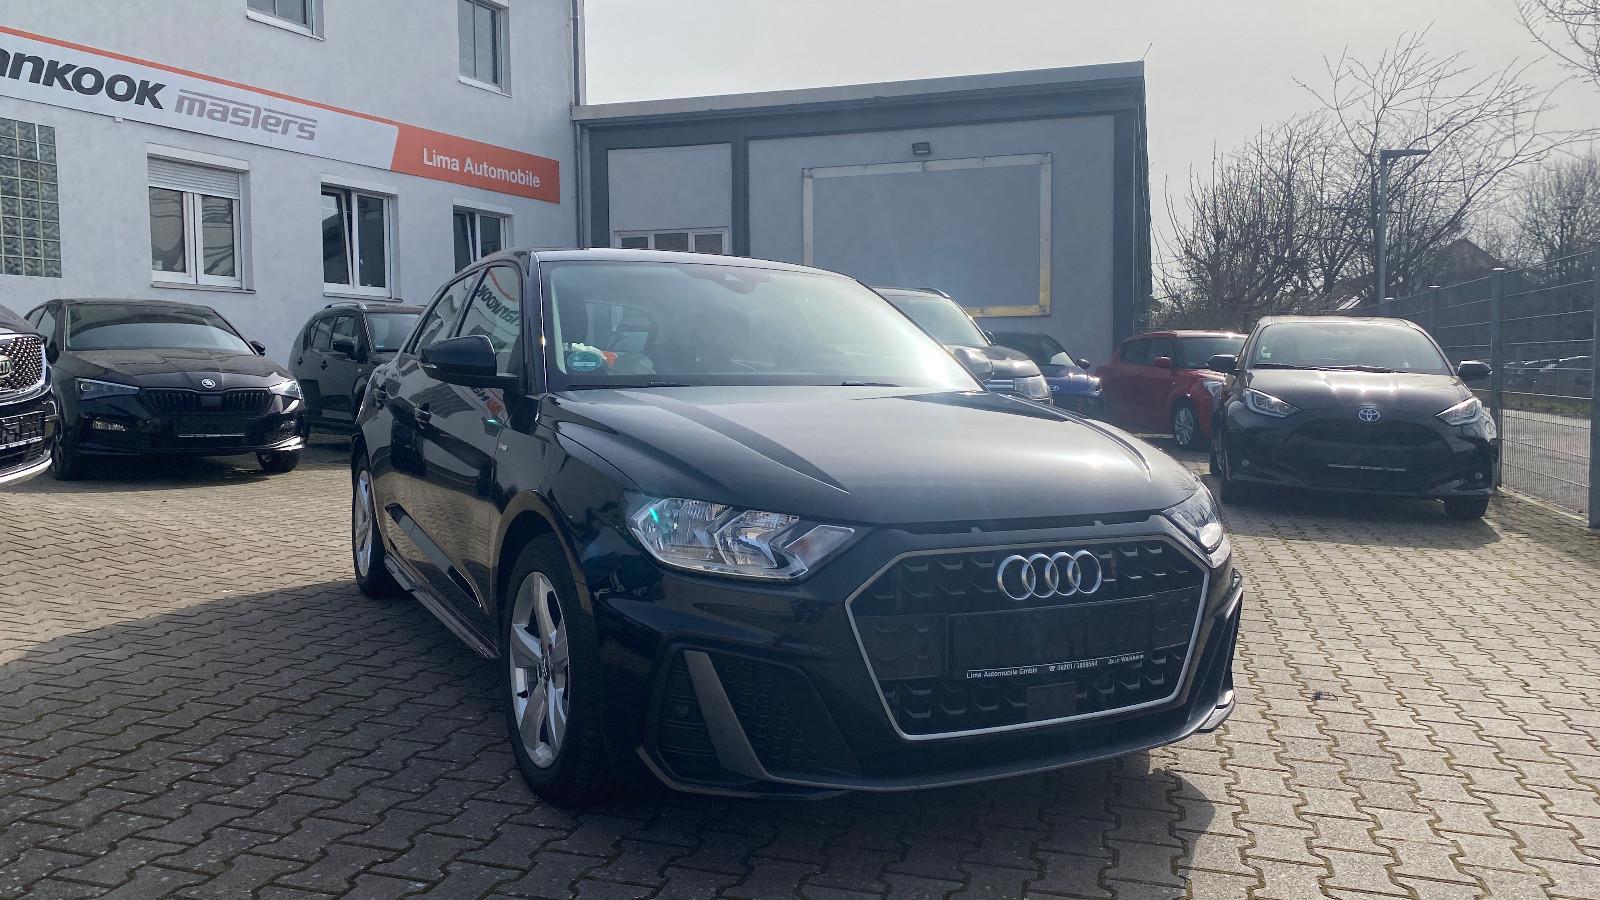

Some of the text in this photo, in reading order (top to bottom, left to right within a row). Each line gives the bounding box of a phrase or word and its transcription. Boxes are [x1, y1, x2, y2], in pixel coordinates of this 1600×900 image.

[174, 89, 318, 141] masters
[423, 147, 541, 188] Lima Automobile
[983, 668, 1018, 678] Automobile
[1019, 666, 1038, 675] GmbH
